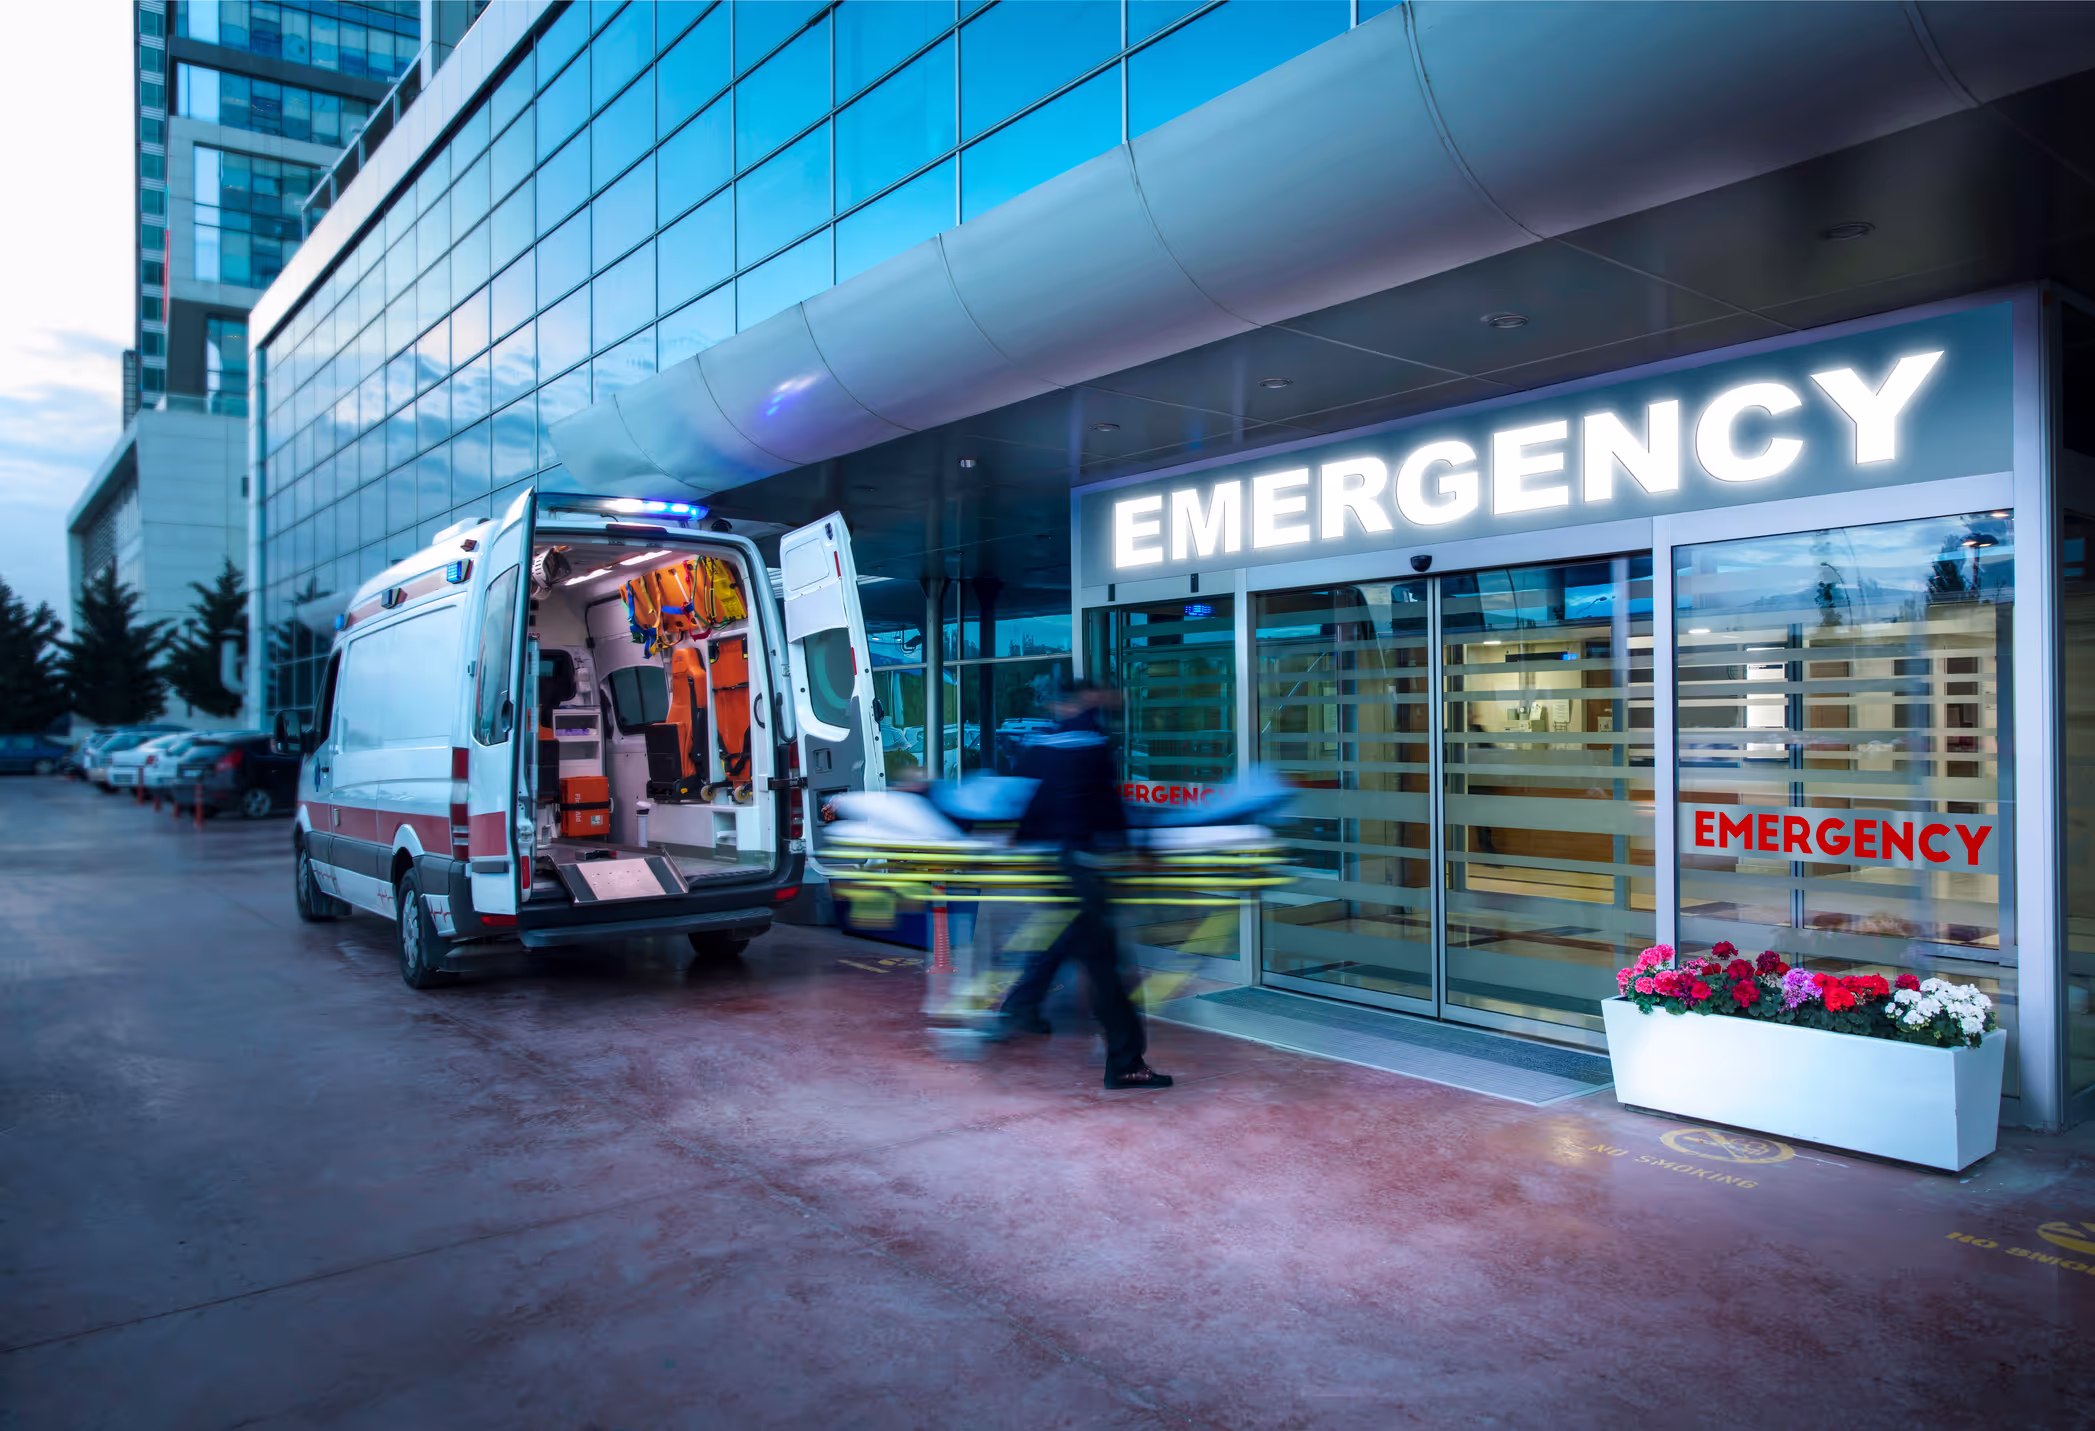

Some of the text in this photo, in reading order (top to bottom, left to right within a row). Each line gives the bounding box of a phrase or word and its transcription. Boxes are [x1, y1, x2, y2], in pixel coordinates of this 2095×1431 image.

[1114, 350, 1945, 570] EMERGENCY
[1115, 782, 1233, 807] ERGENCY
[1694, 810, 1993, 866] EMERGENCY
[1588, 1144, 1760, 1189] NO SMOKING
